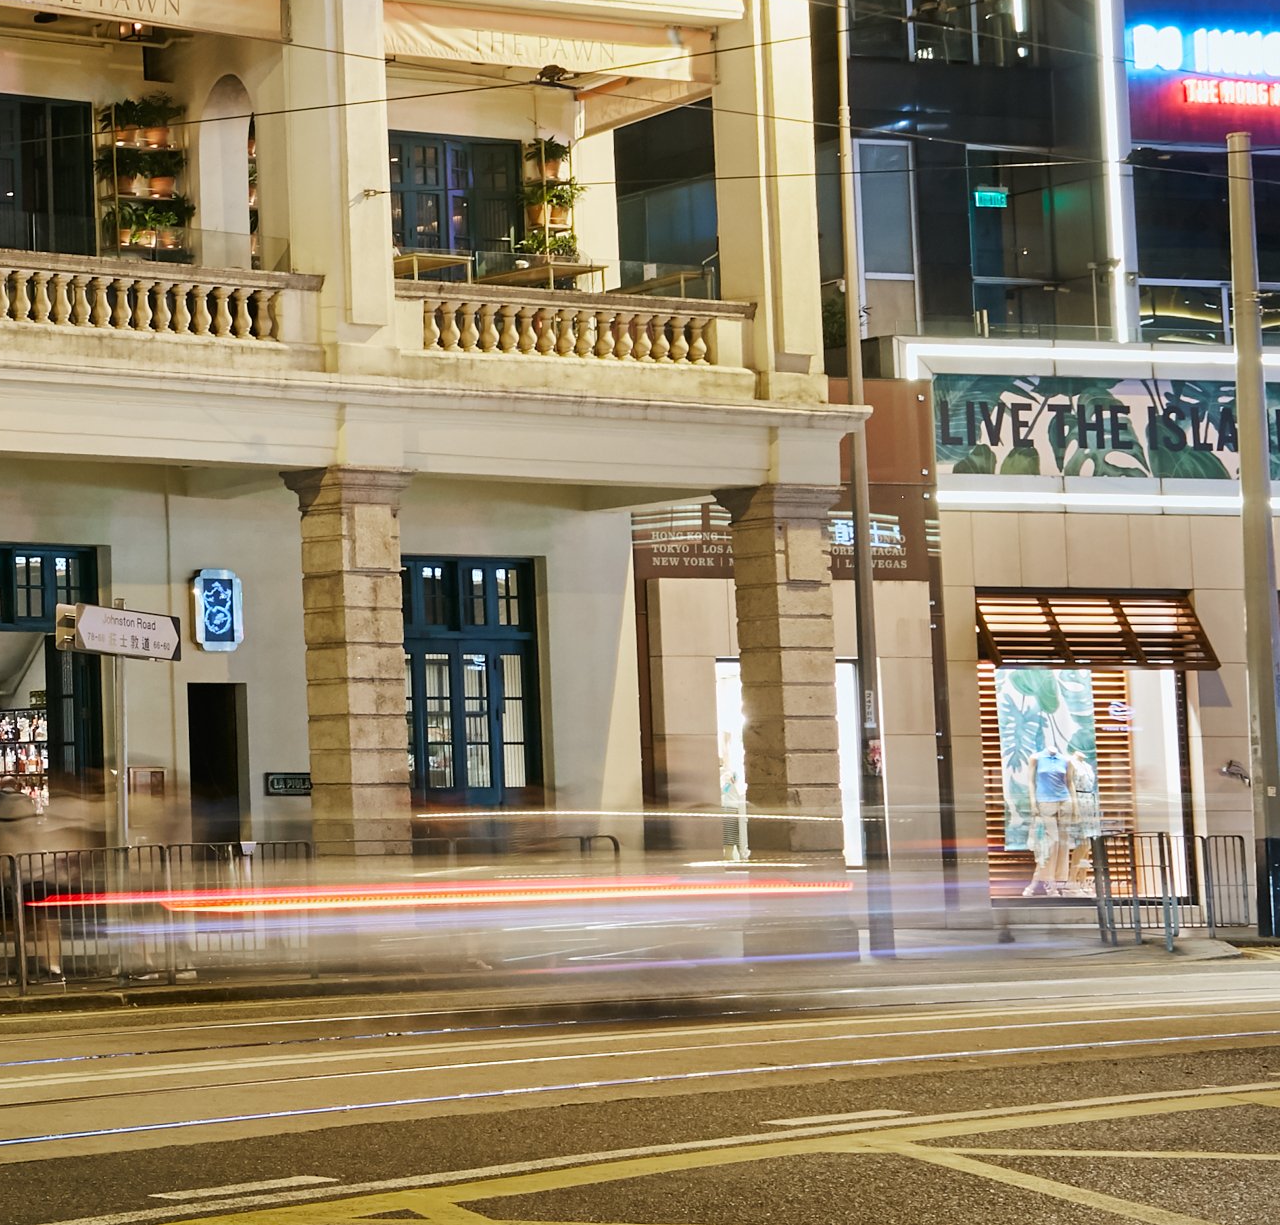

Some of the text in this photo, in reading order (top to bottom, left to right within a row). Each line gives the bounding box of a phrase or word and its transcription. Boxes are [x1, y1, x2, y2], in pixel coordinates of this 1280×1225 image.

[471, 28, 617, 64] THE PAWN
[1183, 78, 1218, 104] THE
[940, 400, 1280, 453] LIVE THE ISLA
[651, 531, 718, 542] HONG KONG
[652, 544, 690, 554] TOKYO
[702, 545, 724, 554] LOS
[652, 557, 715, 567] NEW YORK
[102, 613, 156, 630] Johnston Road
